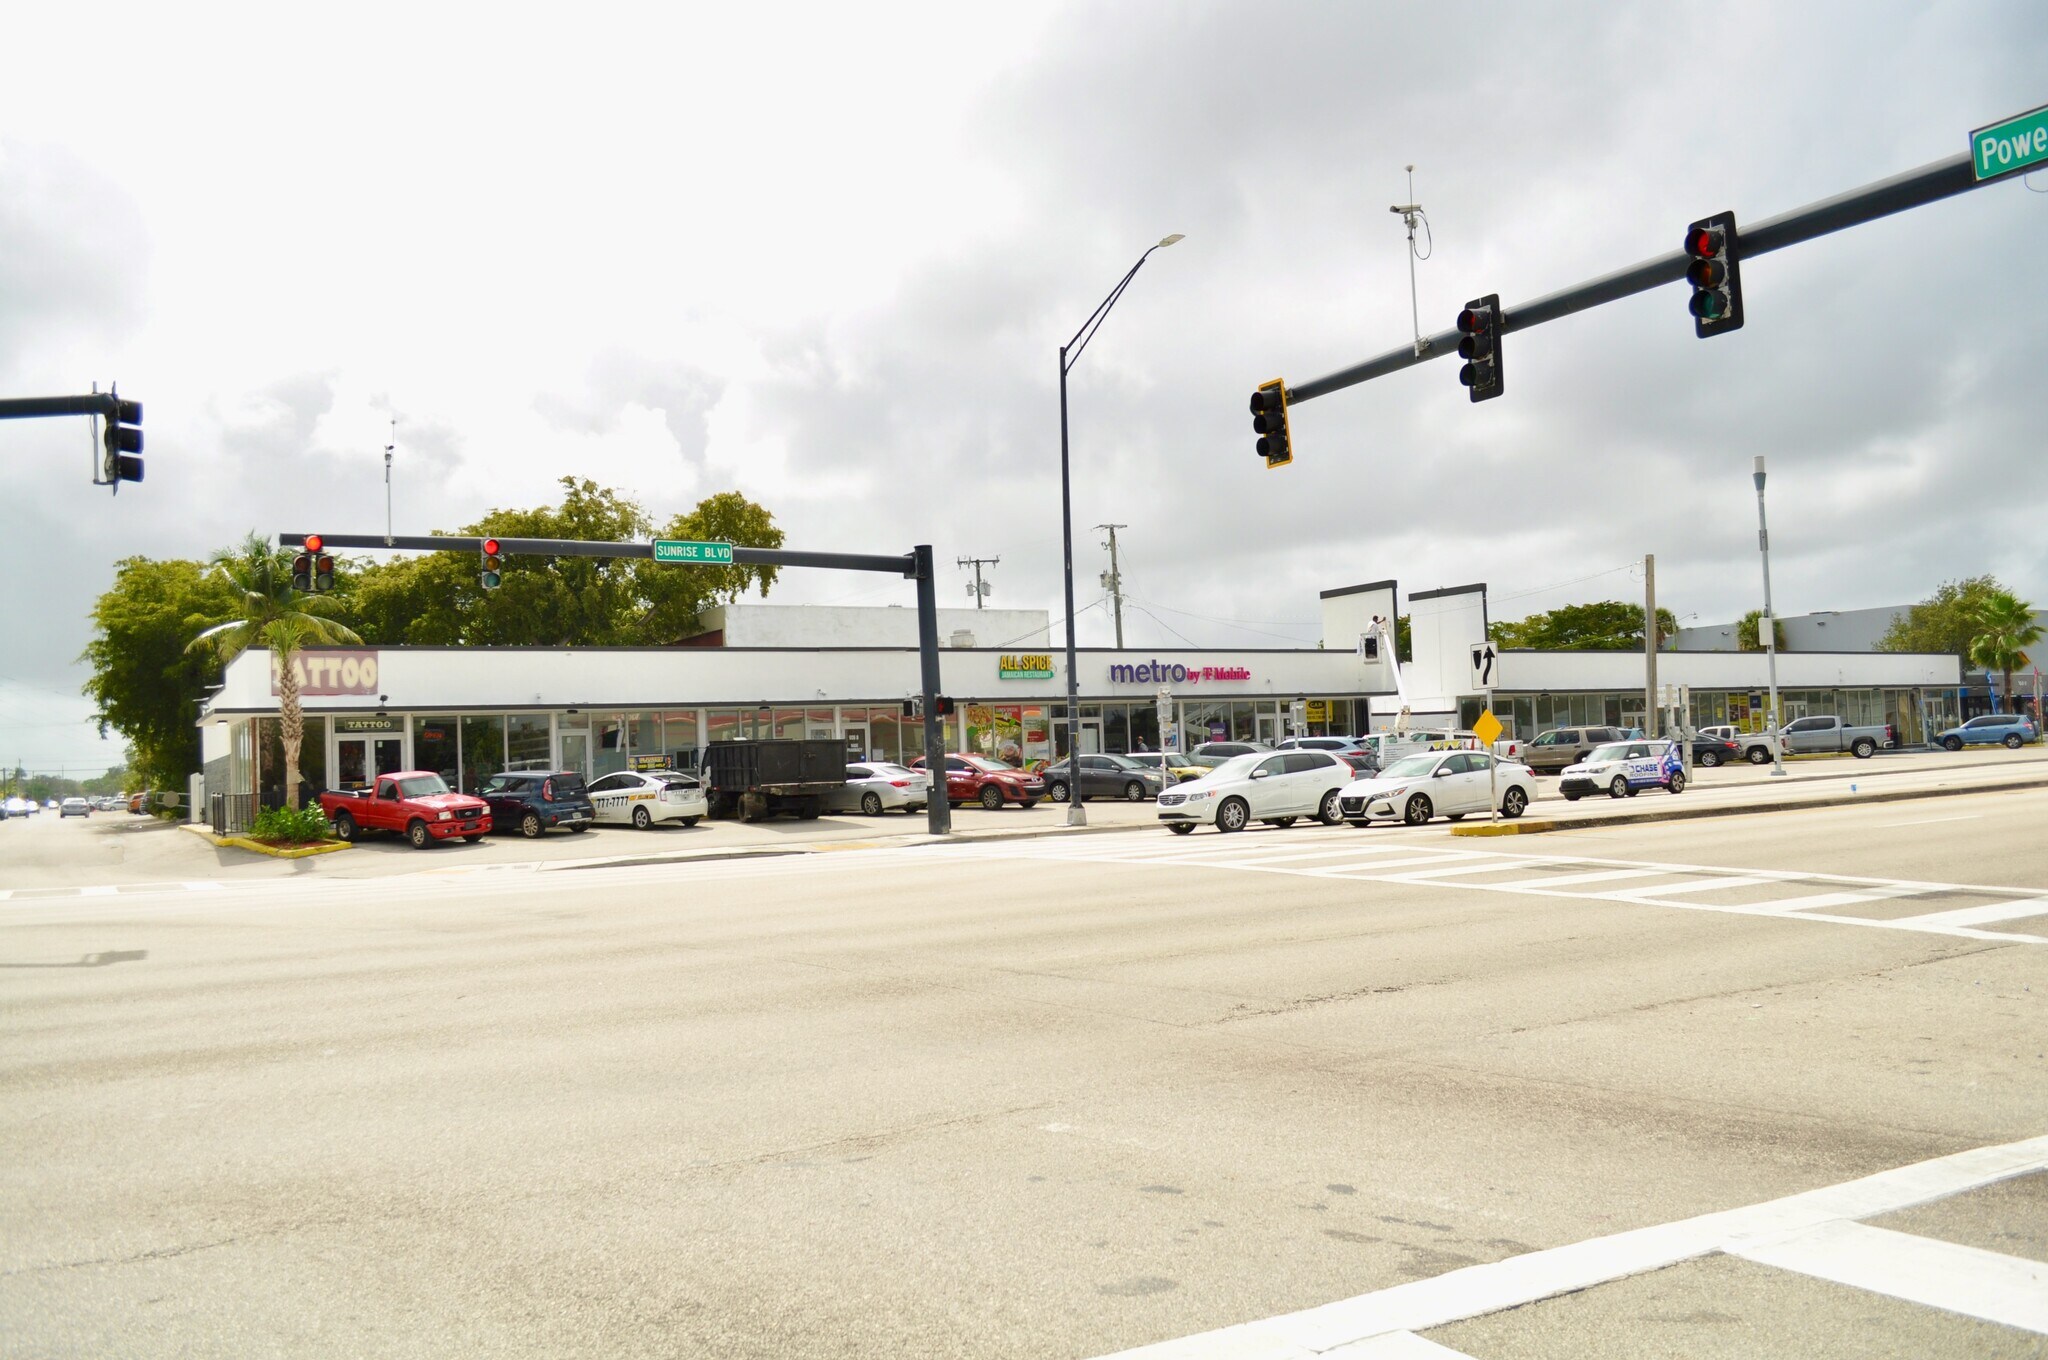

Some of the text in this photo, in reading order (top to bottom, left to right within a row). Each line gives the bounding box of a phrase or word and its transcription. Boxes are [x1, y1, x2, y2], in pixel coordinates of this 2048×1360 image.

[1981, 127, 2047, 170] Powe
[657, 545, 730, 558] SUNRISE BLVD
[1000, 655, 1052, 670] ALL SPICE
[1001, 670, 1051, 678] JAMAICAN RESTAURANT
[1110, 659, 1187, 683] metro
[1186, 667, 1201, 684] by
[1635, 763, 1658, 773] CHASE
[596, 795, 629, 808] 777-7777
